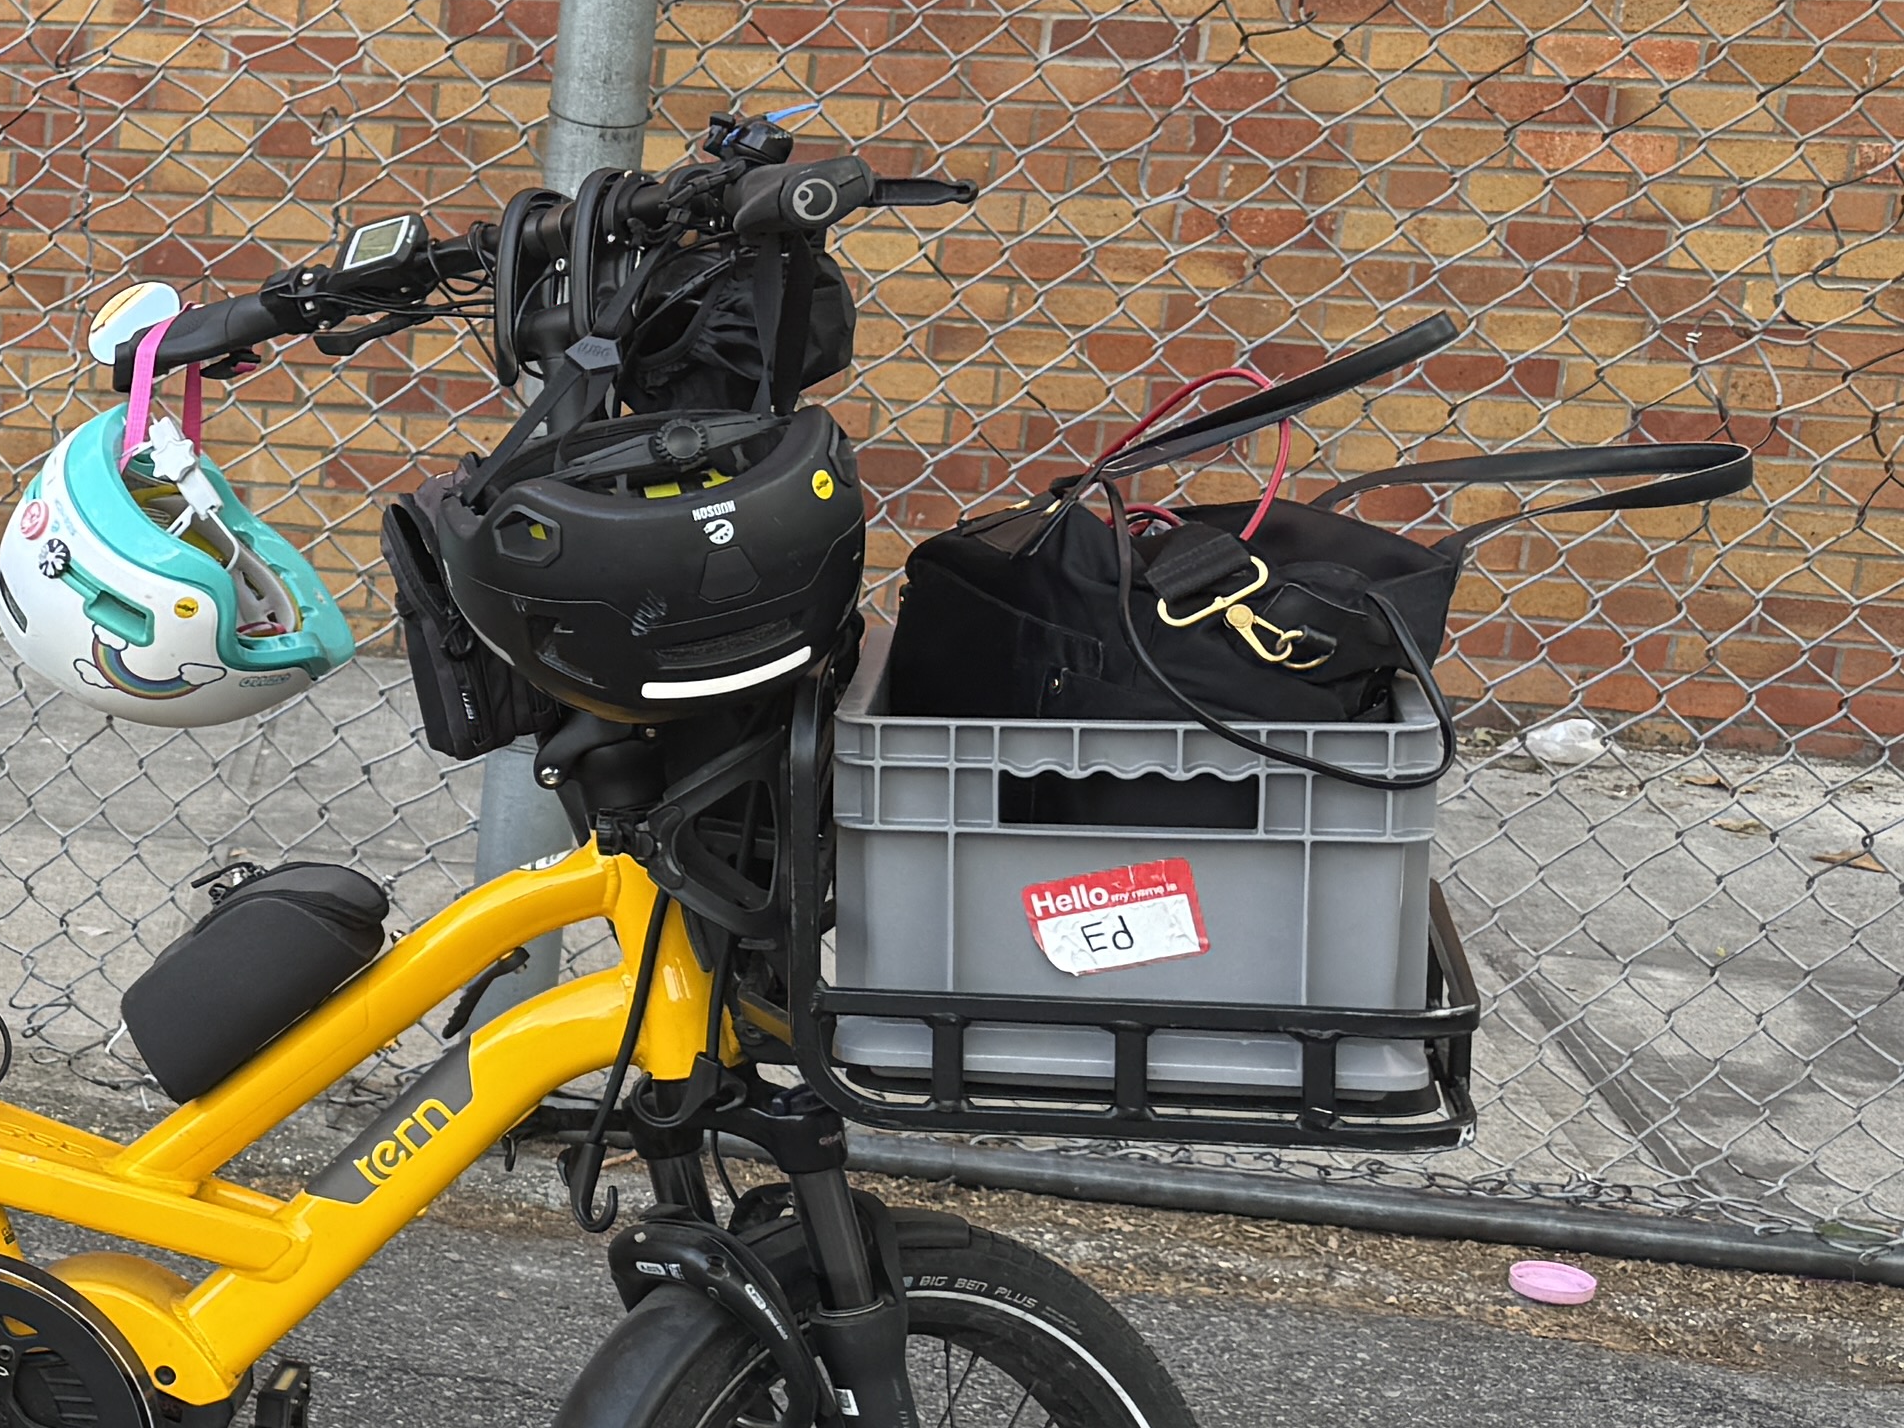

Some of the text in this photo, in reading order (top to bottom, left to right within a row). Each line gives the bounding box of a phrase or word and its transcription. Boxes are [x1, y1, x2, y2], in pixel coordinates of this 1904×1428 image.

[692, 500, 736, 521] HUDSON
[1031, 883, 1109, 917] Hello
[1110, 891, 1129, 903] my
[1131, 885, 1165, 899] name
[1080, 915, 1134, 952] Ed
[353, 1098, 455, 1186] tern
[919, 1275, 948, 1287] BIG
[994, 1286, 1039, 1309] PLUS
